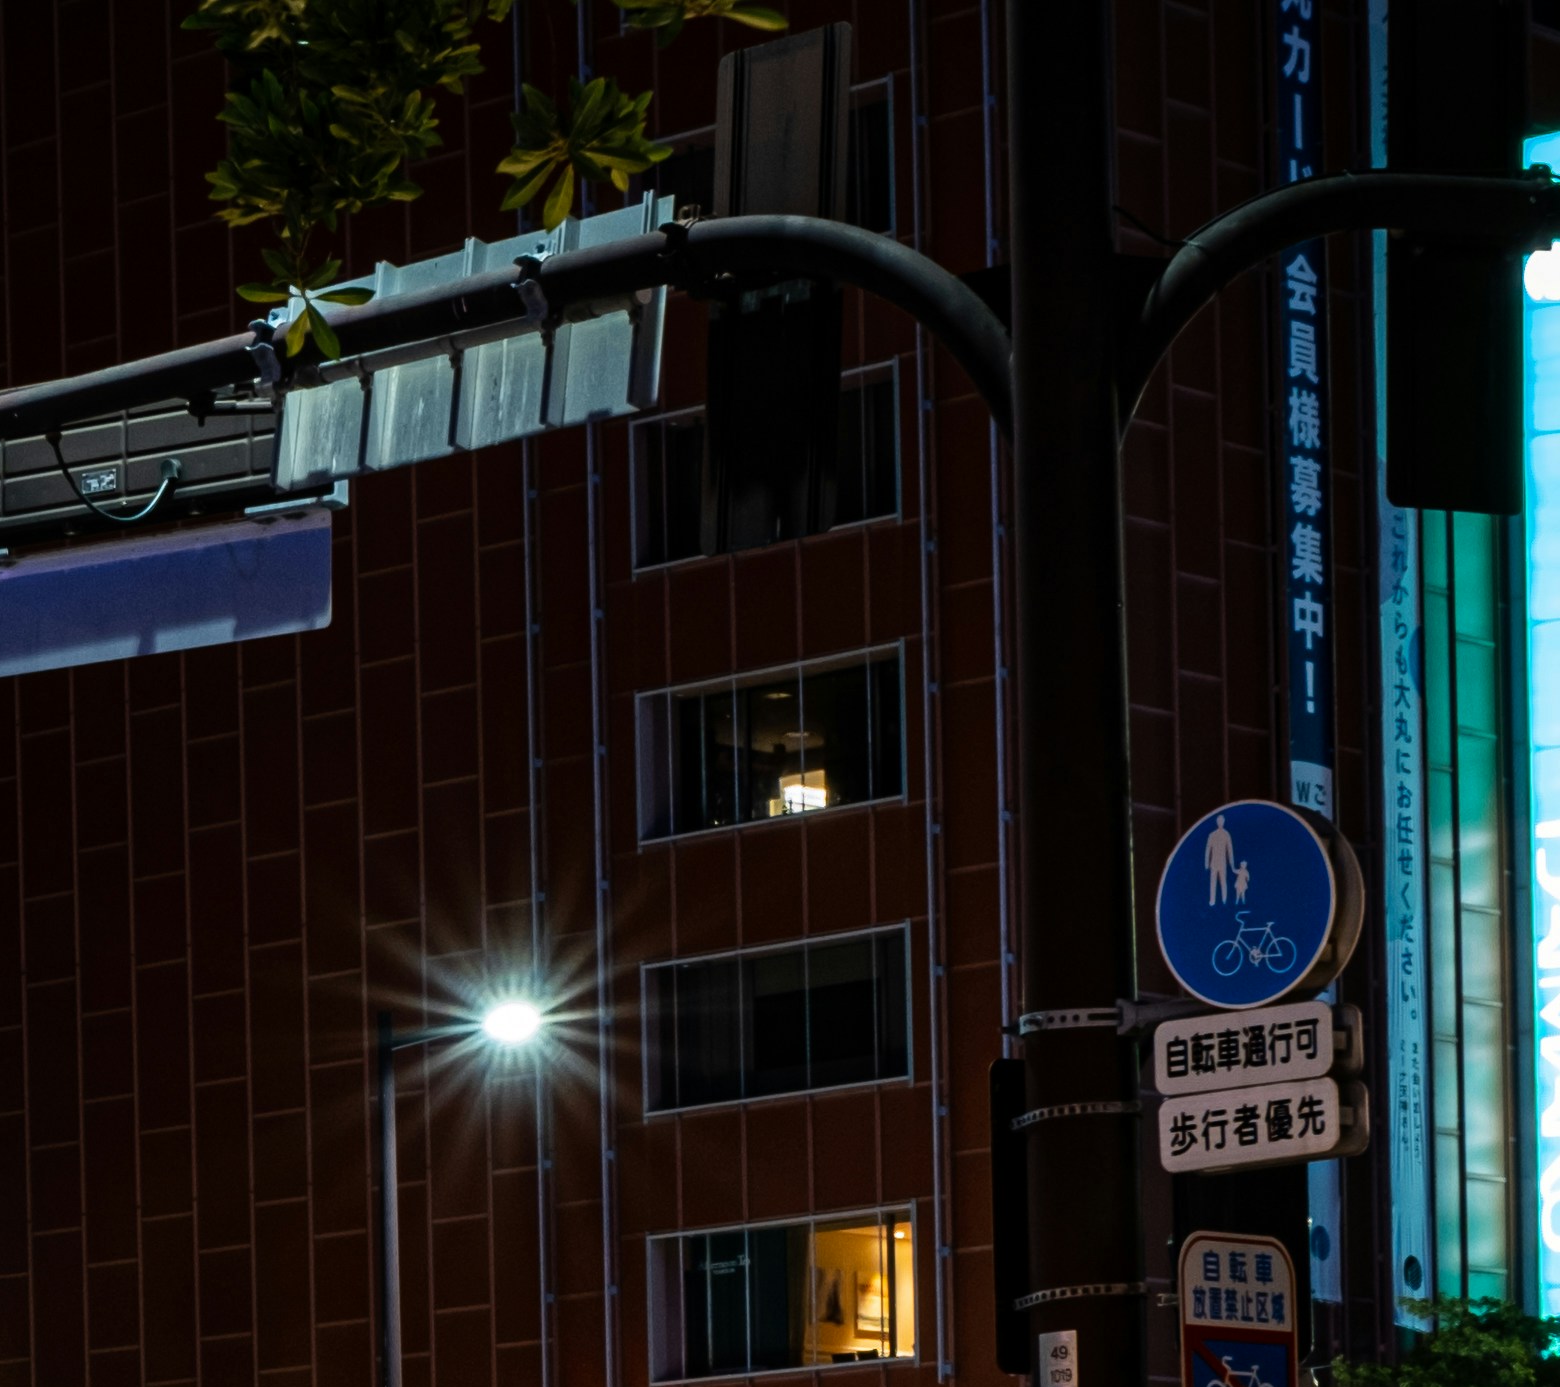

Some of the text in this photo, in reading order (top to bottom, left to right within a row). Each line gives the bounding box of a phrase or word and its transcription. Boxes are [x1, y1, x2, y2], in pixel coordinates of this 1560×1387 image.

[1167, 1018, 1319, 1078] 自転車通行可
[1170, 1096, 1325, 1157] 歩行者優先
[1203, 1250, 1273, 1285] 自転車
[1193, 1286, 1285, 1324] 放置禁止区域
[1051, 1345, 1068, 1360] 49
